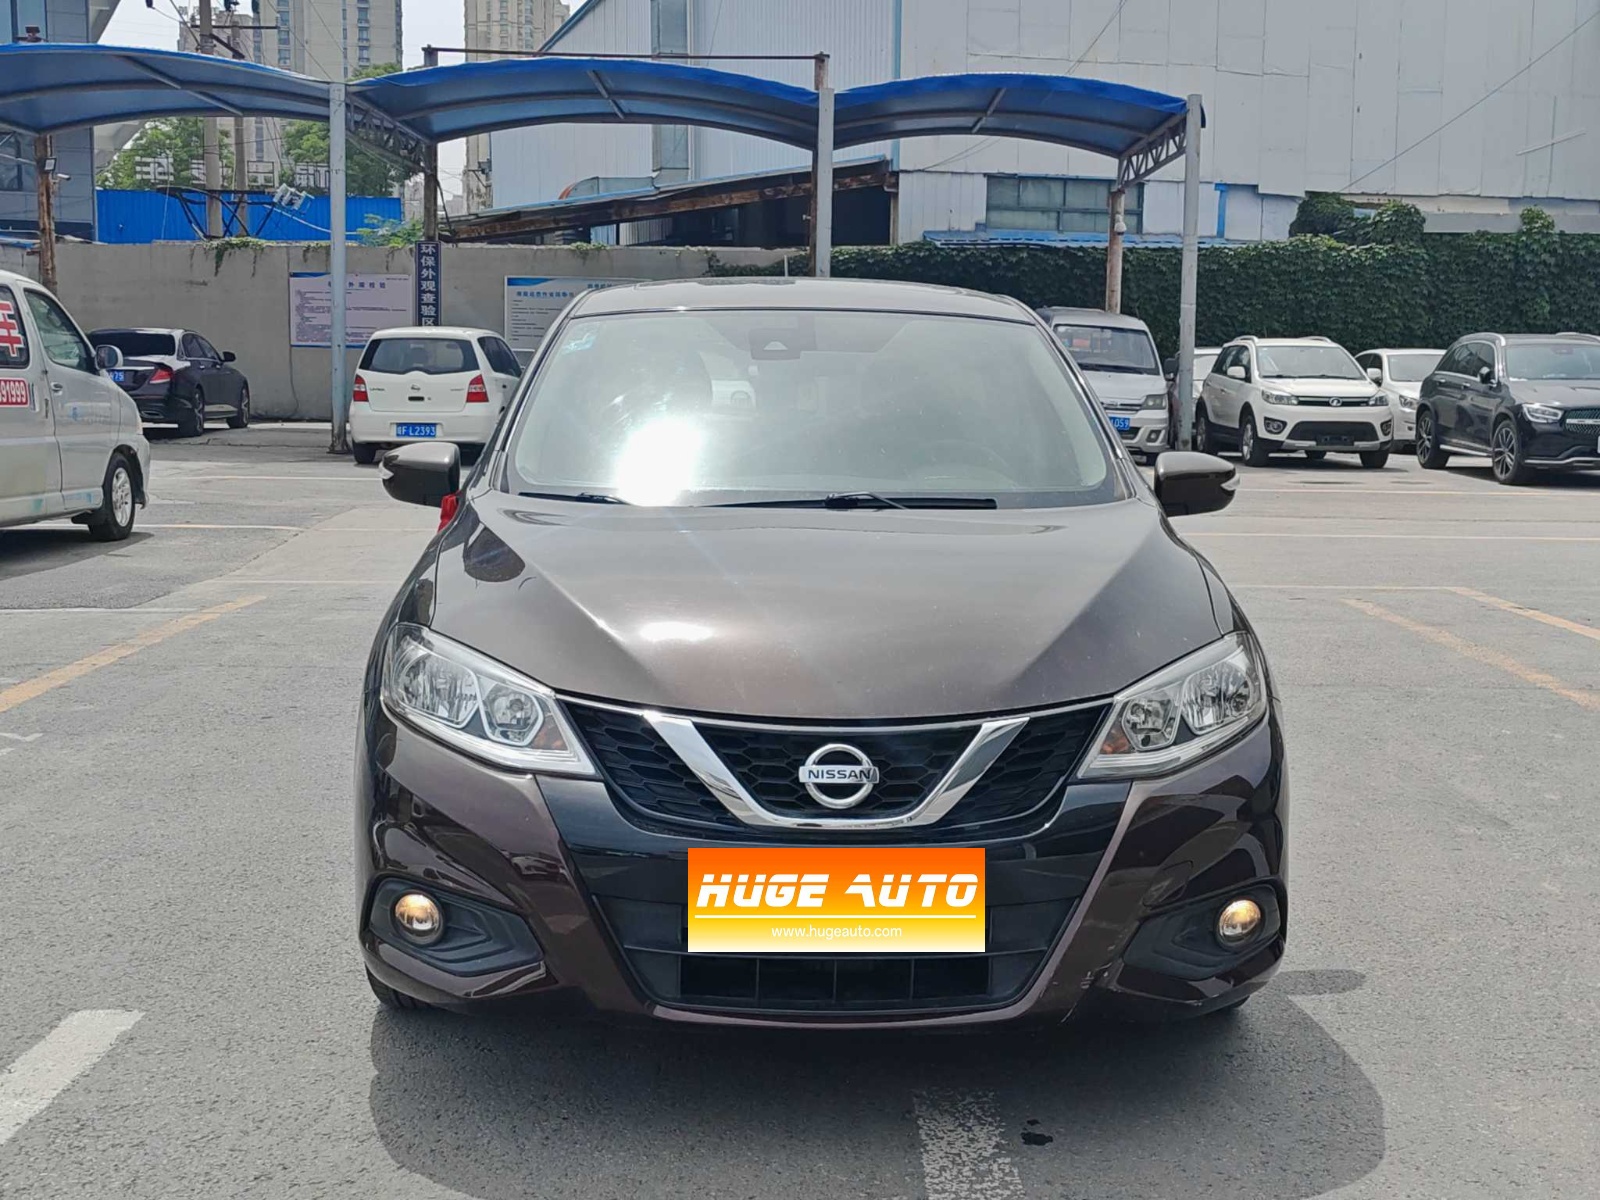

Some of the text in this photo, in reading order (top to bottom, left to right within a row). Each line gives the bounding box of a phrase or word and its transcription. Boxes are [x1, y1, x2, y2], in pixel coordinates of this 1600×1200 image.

[420, 244, 437, 327] 环保外观查验区
[0, 381, 26, 403] 91999
[808, 769, 871, 780] NISSAN
